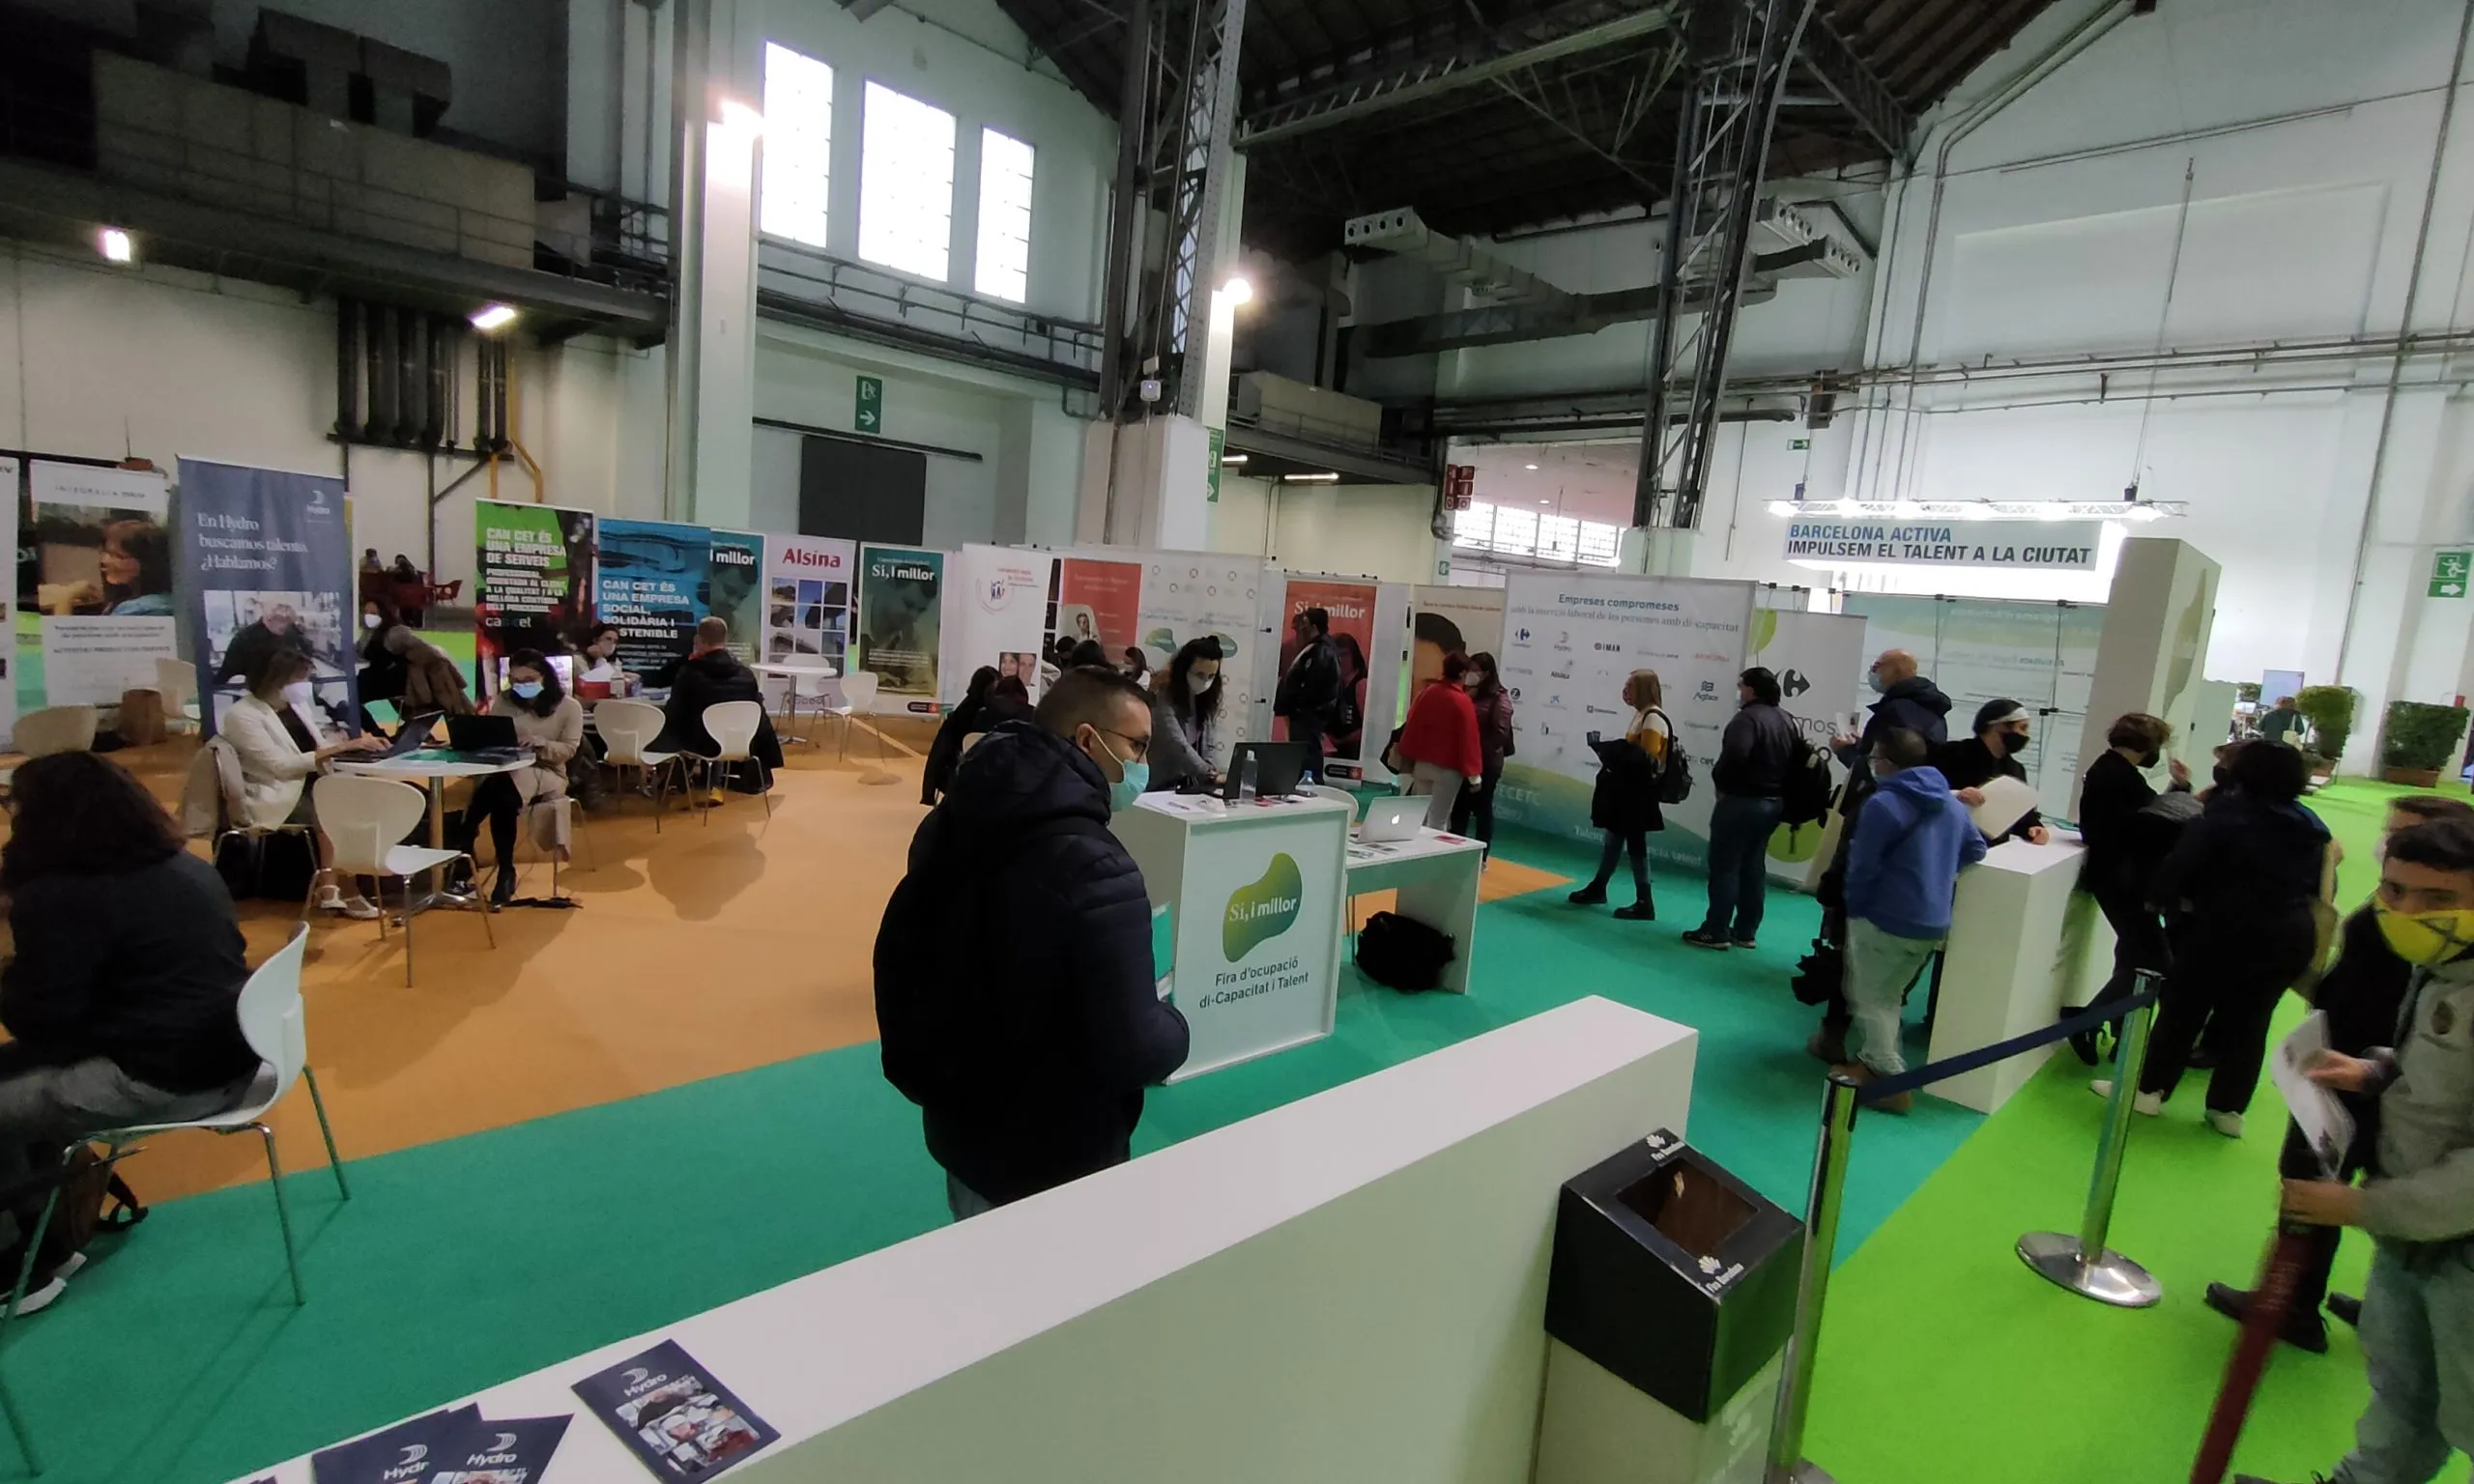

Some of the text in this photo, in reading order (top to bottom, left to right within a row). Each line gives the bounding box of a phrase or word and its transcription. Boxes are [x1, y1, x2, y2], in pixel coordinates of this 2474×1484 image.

[197, 512, 259, 532] En Hydro
[198, 533, 265, 550] buscamos
[486, 528, 511, 540] CAN
[514, 529, 534, 542] CET
[1790, 524, 1951, 543] BARCELONA ACTIVA
[486, 540, 567, 556] UNA EMPRESA
[1788, 540, 2091, 563] IMPULSEM EL TALENT A LA CIUTAT
[201, 554, 278, 571] ¿Hablamos?
[486, 552, 550, 567] DE SERVEIS
[716, 551, 756, 565] millor
[782, 548, 841, 568] Alsina
[897, 567, 935, 581] millor
[504, 586, 540, 595] QUALITAT
[602, 580, 676, 592] CAN CET ÉS
[602, 592, 690, 605] UNA EMPRESA
[1558, 593, 1680, 613] Empreses compromeses
[602, 604, 650, 615] SOCIAL,
[1324, 604, 1366, 618] millor
[1528, 606, 1535, 615] la
[1567, 609, 1595, 619] laboral
[1597, 610, 1605, 619] de
[1608, 612, 1619, 621] les
[1661, 616, 1681, 627] amb
[602, 615, 668, 627] SOLIDÀRIA
[619, 629, 677, 640] STENIBLE
[1251, 901, 1255, 919] i
[1257, 897, 1297, 917] millor
[1215, 955, 1299, 987] Fira d'ocupació
[1199, 971, 1309, 1010] di-Capacitat i Talent
[624, 1374, 667, 1397] Hydro
[467, 1452, 517, 1468] Hydro
[384, 1461, 430, 1480] Hydr
